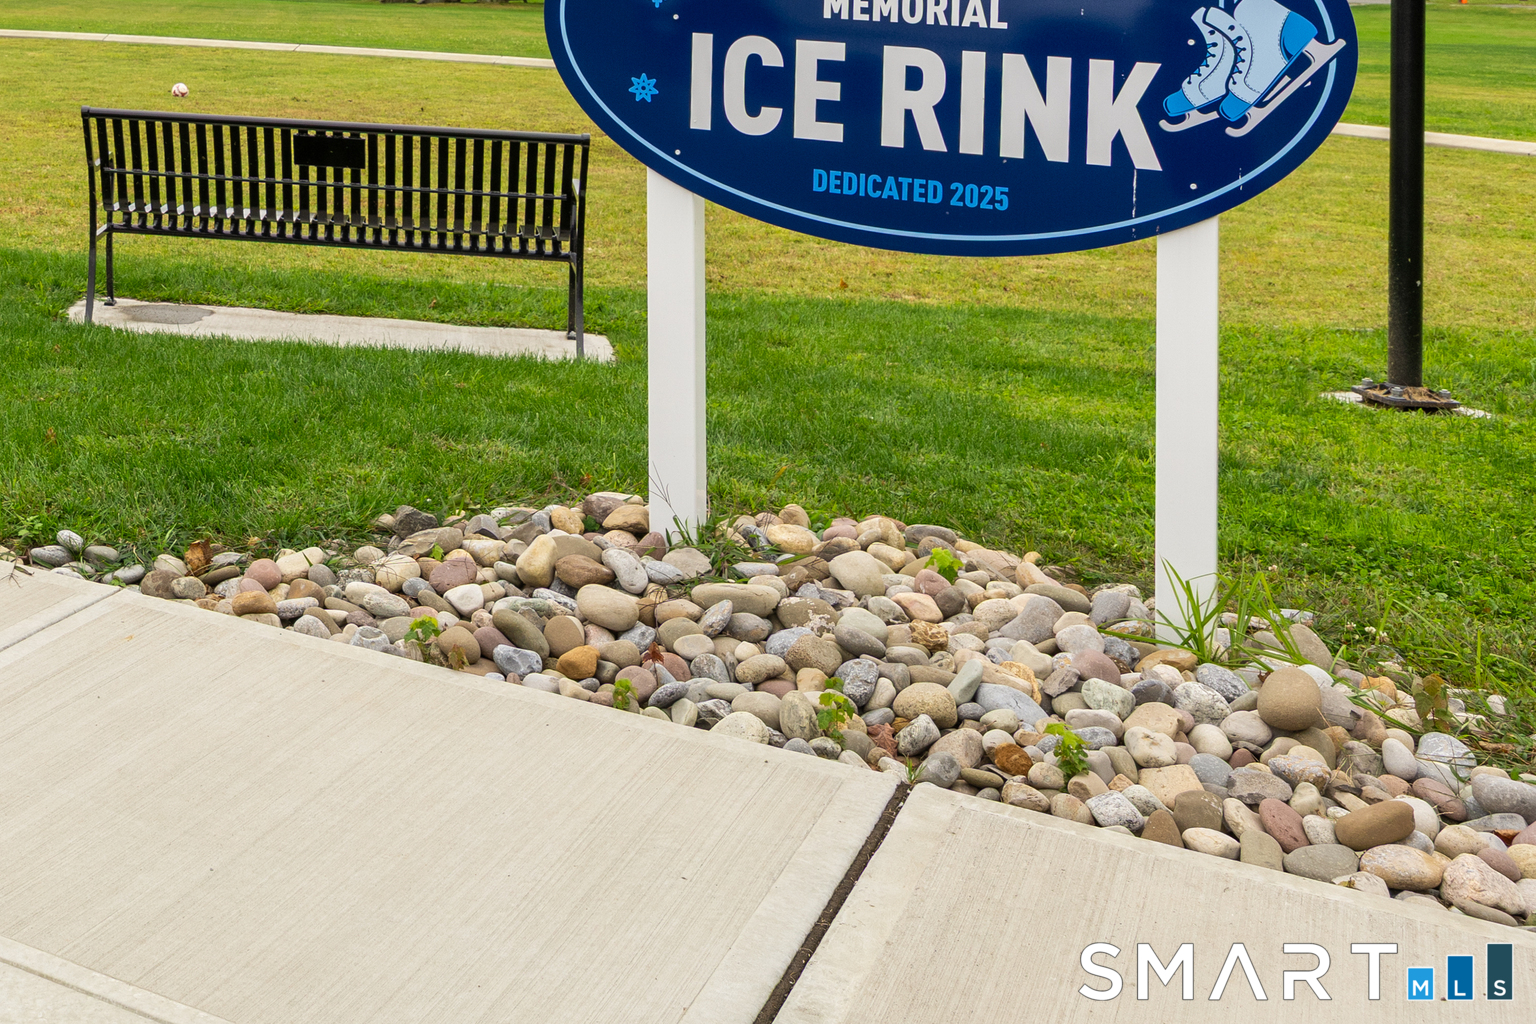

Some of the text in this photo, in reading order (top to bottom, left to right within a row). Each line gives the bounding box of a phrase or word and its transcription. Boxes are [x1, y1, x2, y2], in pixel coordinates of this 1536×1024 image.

[689, 32, 1163, 172] ICE RINK
[812, 168, 1009, 211] DEDICATED 2025
